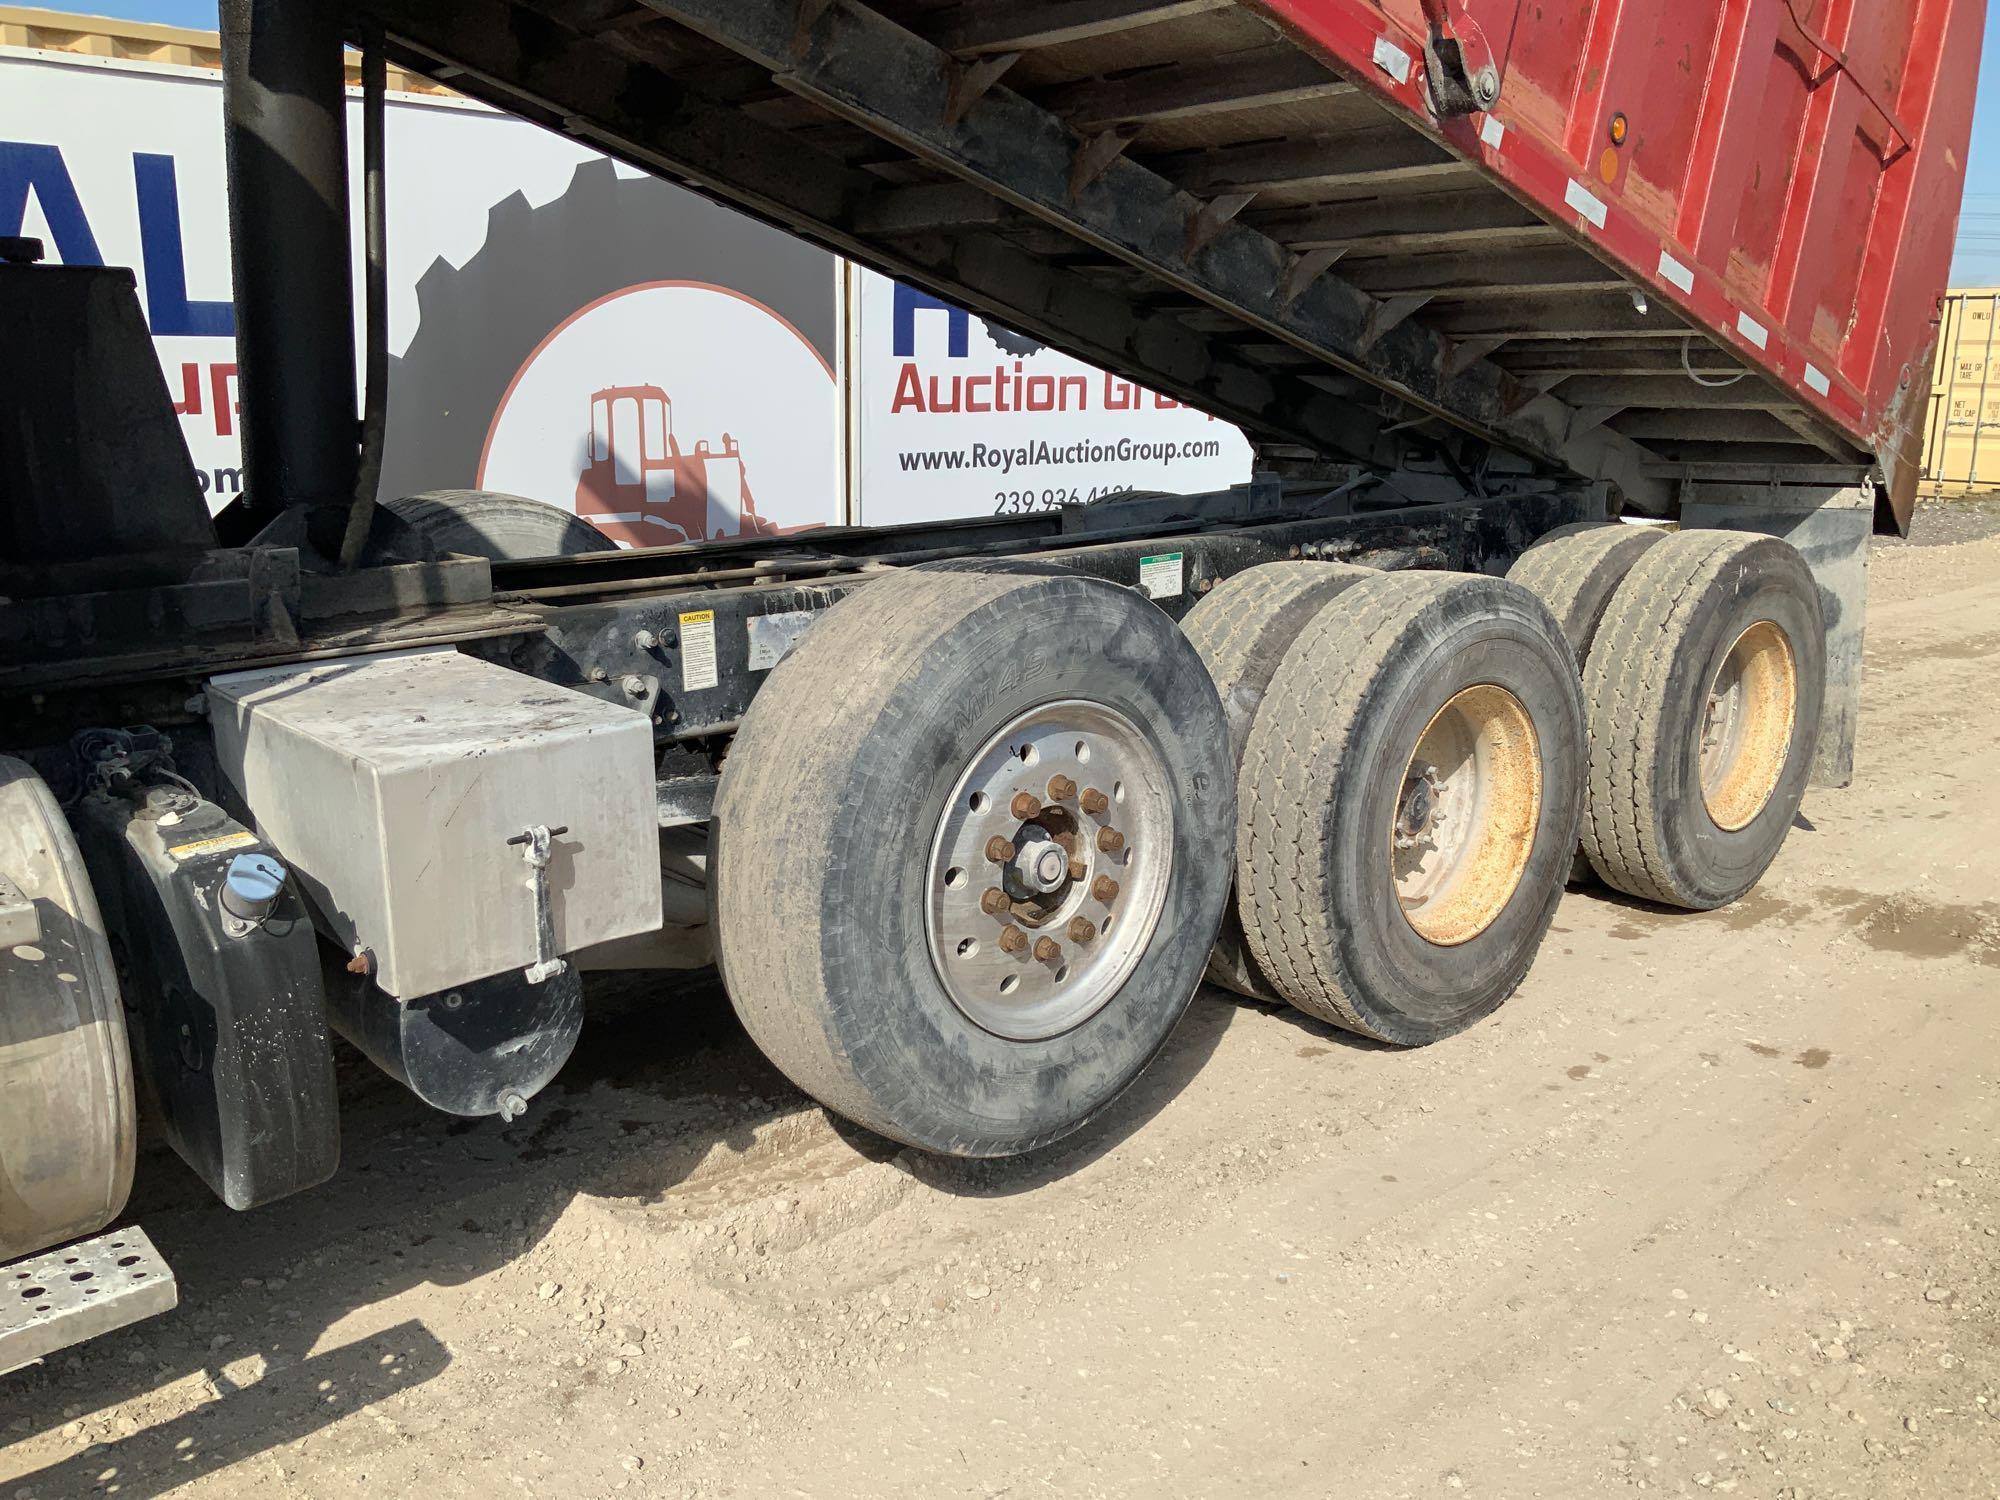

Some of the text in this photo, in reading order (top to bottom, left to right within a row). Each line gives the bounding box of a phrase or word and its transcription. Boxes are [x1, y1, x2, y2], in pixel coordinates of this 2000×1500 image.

[891, 361, 1087, 413] Auction
[898, 438, 1220, 474] www.RoyalAuctionGroup.com
[683, 612, 711, 621] CAUTION
